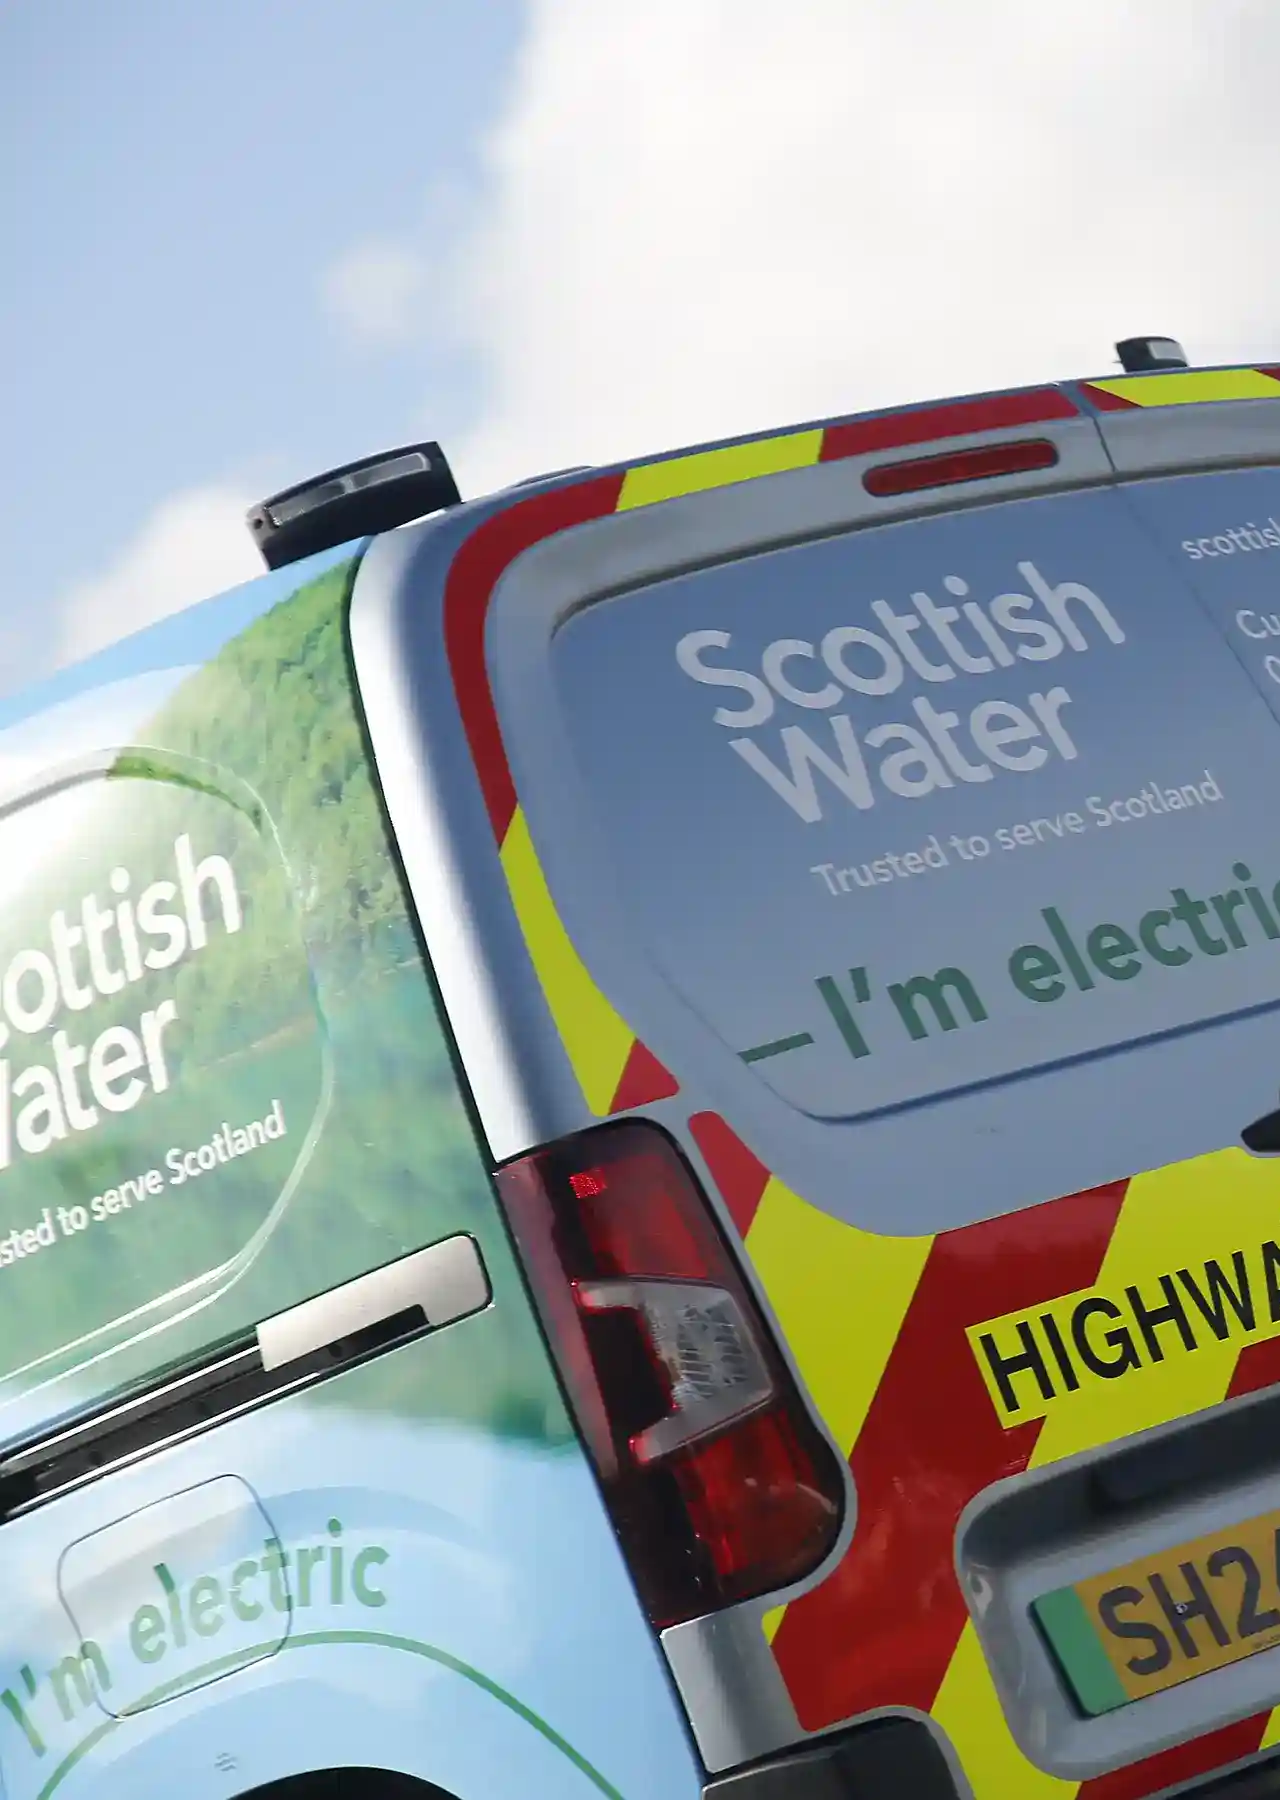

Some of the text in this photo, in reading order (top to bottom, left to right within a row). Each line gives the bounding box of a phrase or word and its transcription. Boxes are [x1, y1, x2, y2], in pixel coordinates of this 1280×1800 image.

[675, 561, 1126, 728] Scottish
[727, 686, 1077, 823] Water
[810, 769, 1225, 897] Trusted to serve Scotland
[0, 833, 243, 1050] ottish
[814, 966, 989, 1060] I'm
[56, 1203, 88, 1236] to
[91, 1169, 164, 1222] serve
[165, 1100, 288, 1186] Scotland
[1, 1517, 391, 1758] I'm electric
